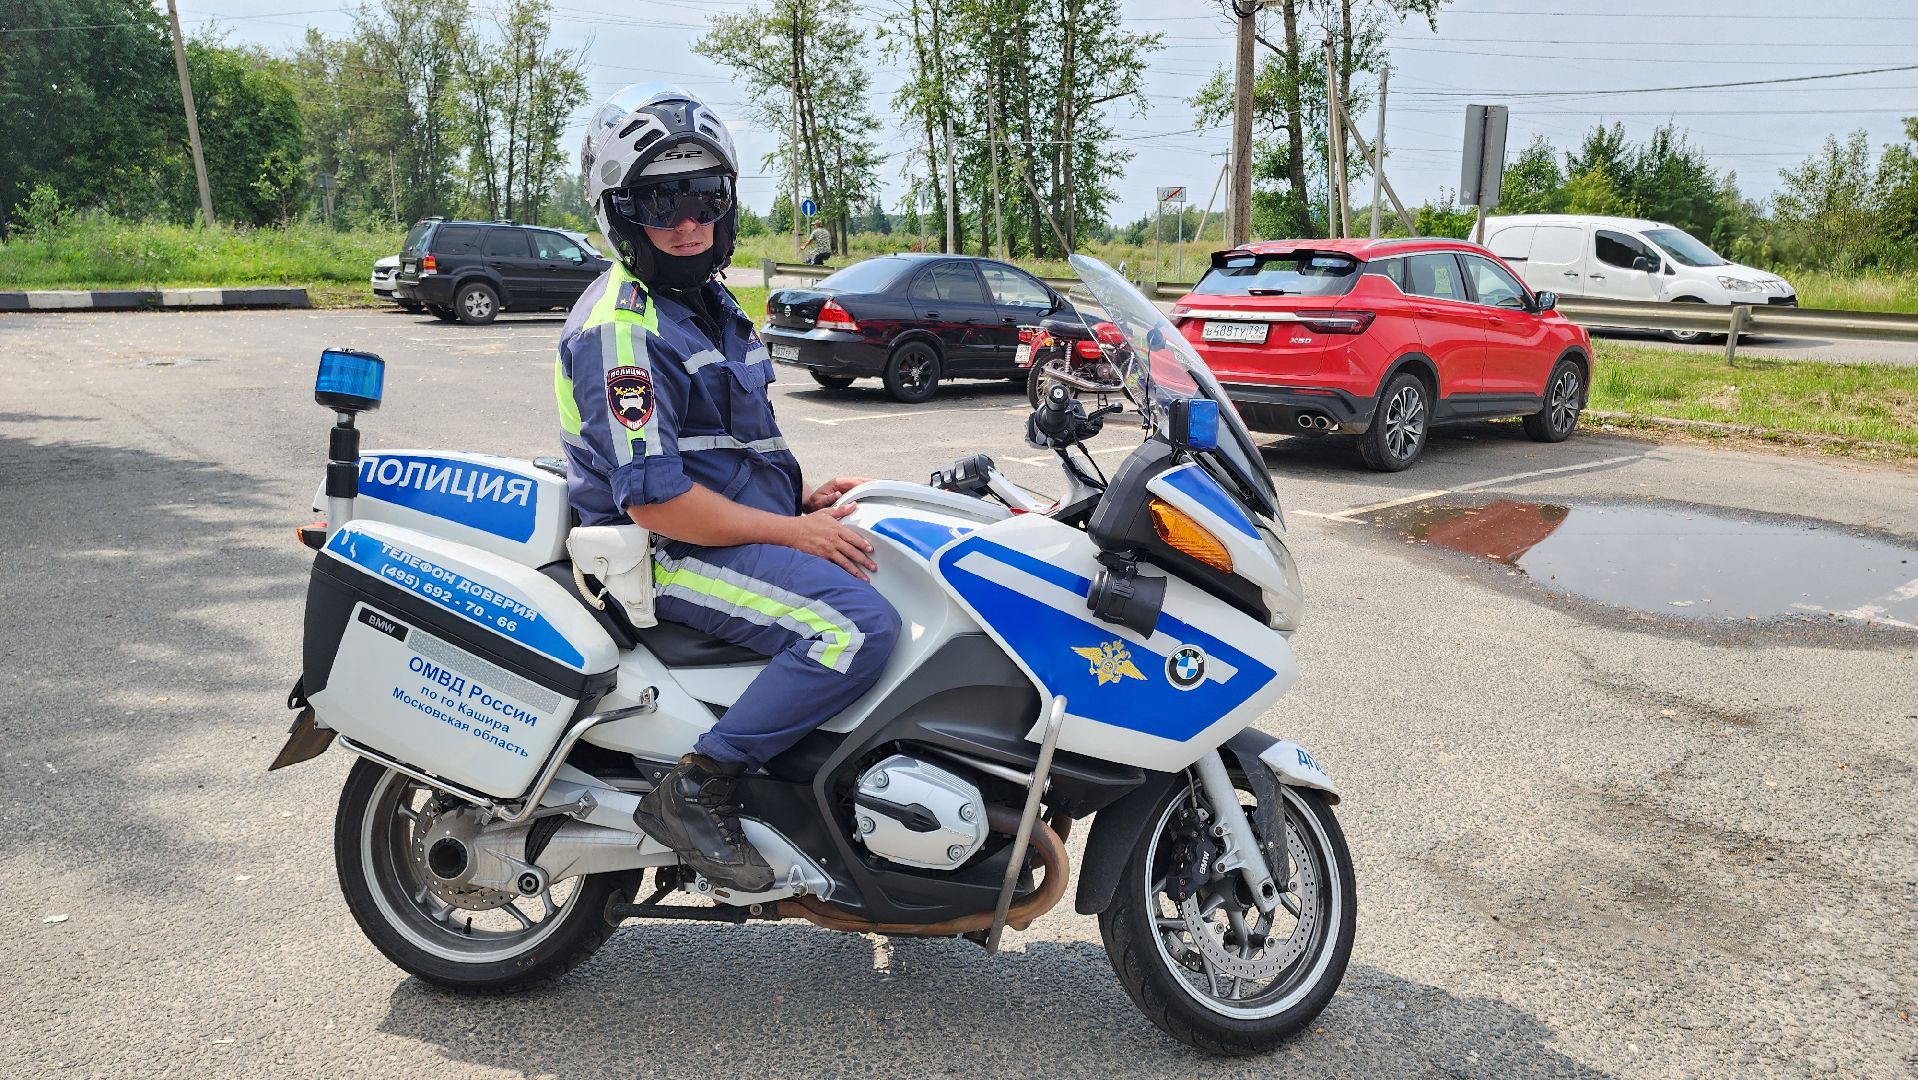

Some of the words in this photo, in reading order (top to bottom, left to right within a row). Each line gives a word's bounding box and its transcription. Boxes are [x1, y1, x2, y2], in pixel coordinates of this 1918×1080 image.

[610, 368, 647, 379] ПОЛИЦИЯ
[358, 456, 533, 507] ПОЛИЦИЯ
[381, 543, 457, 585] ТЕЛЕФОН
[456, 578, 539, 622] ДОВЕРИЯ
[381, 563, 421, 589] (495)
[423, 583, 453, 603] 692
[466, 601, 485, 617] 70
[497, 617, 518, 632] 66
[369, 615, 396, 634] BMW
[409, 656, 466, 697] ОМВД
[392, 687, 470, 732] Московская
[473, 729, 529, 758] область
[420, 686, 438, 700] по
[440, 696, 455, 708] го
[457, 702, 510, 733] Кашира
[1199, 850, 1210, 875] BMW
